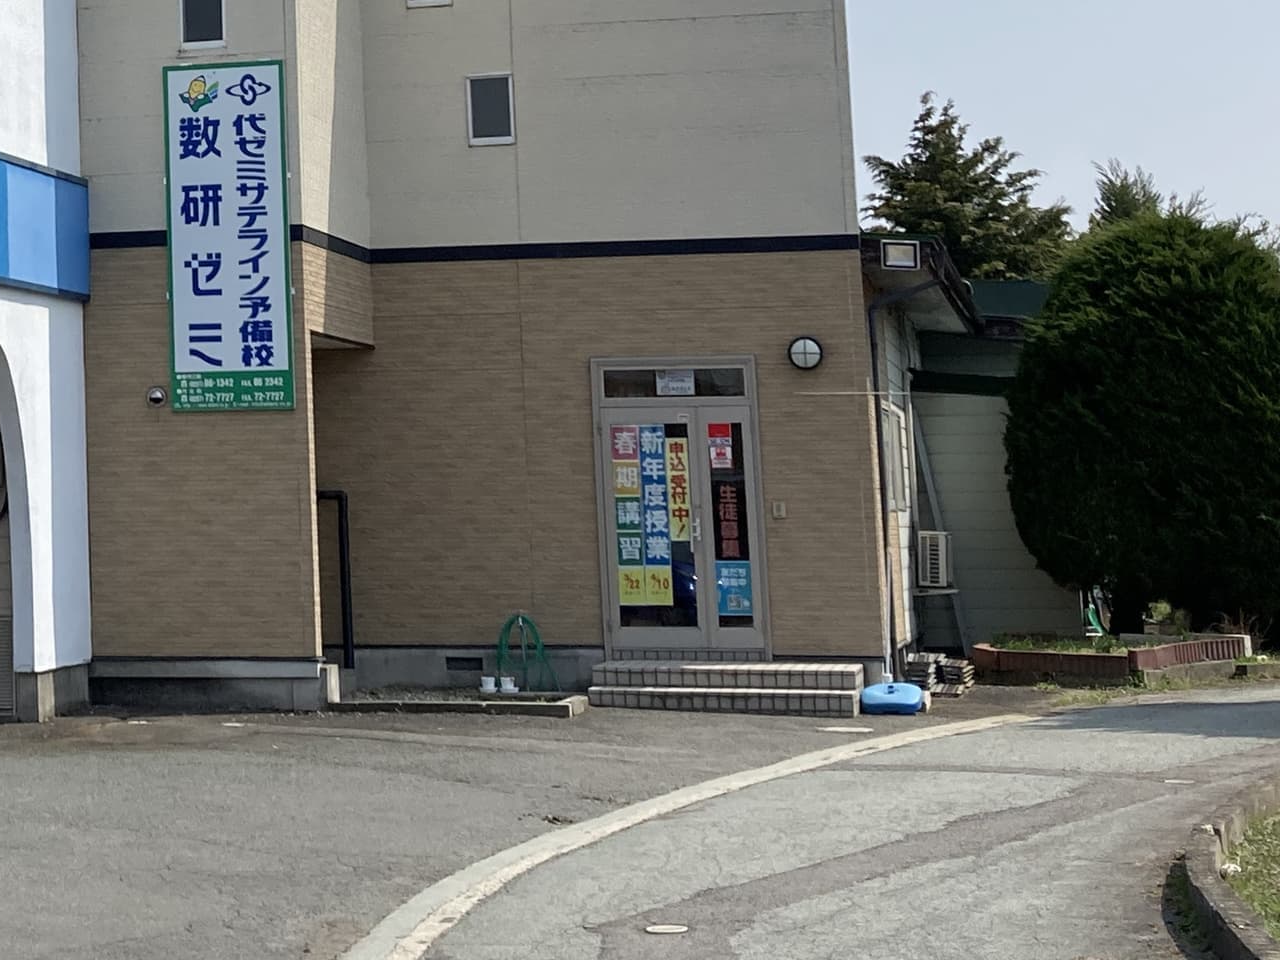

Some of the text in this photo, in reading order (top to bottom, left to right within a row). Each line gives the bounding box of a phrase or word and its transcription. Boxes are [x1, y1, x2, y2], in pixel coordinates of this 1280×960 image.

[179, 116, 223, 367] 数研ゼミ
[232, 113, 274, 367] 代ゼミサテライン予備校
[614, 431, 641, 560] 春期講習
[641, 431, 670, 560] 新年度授業
